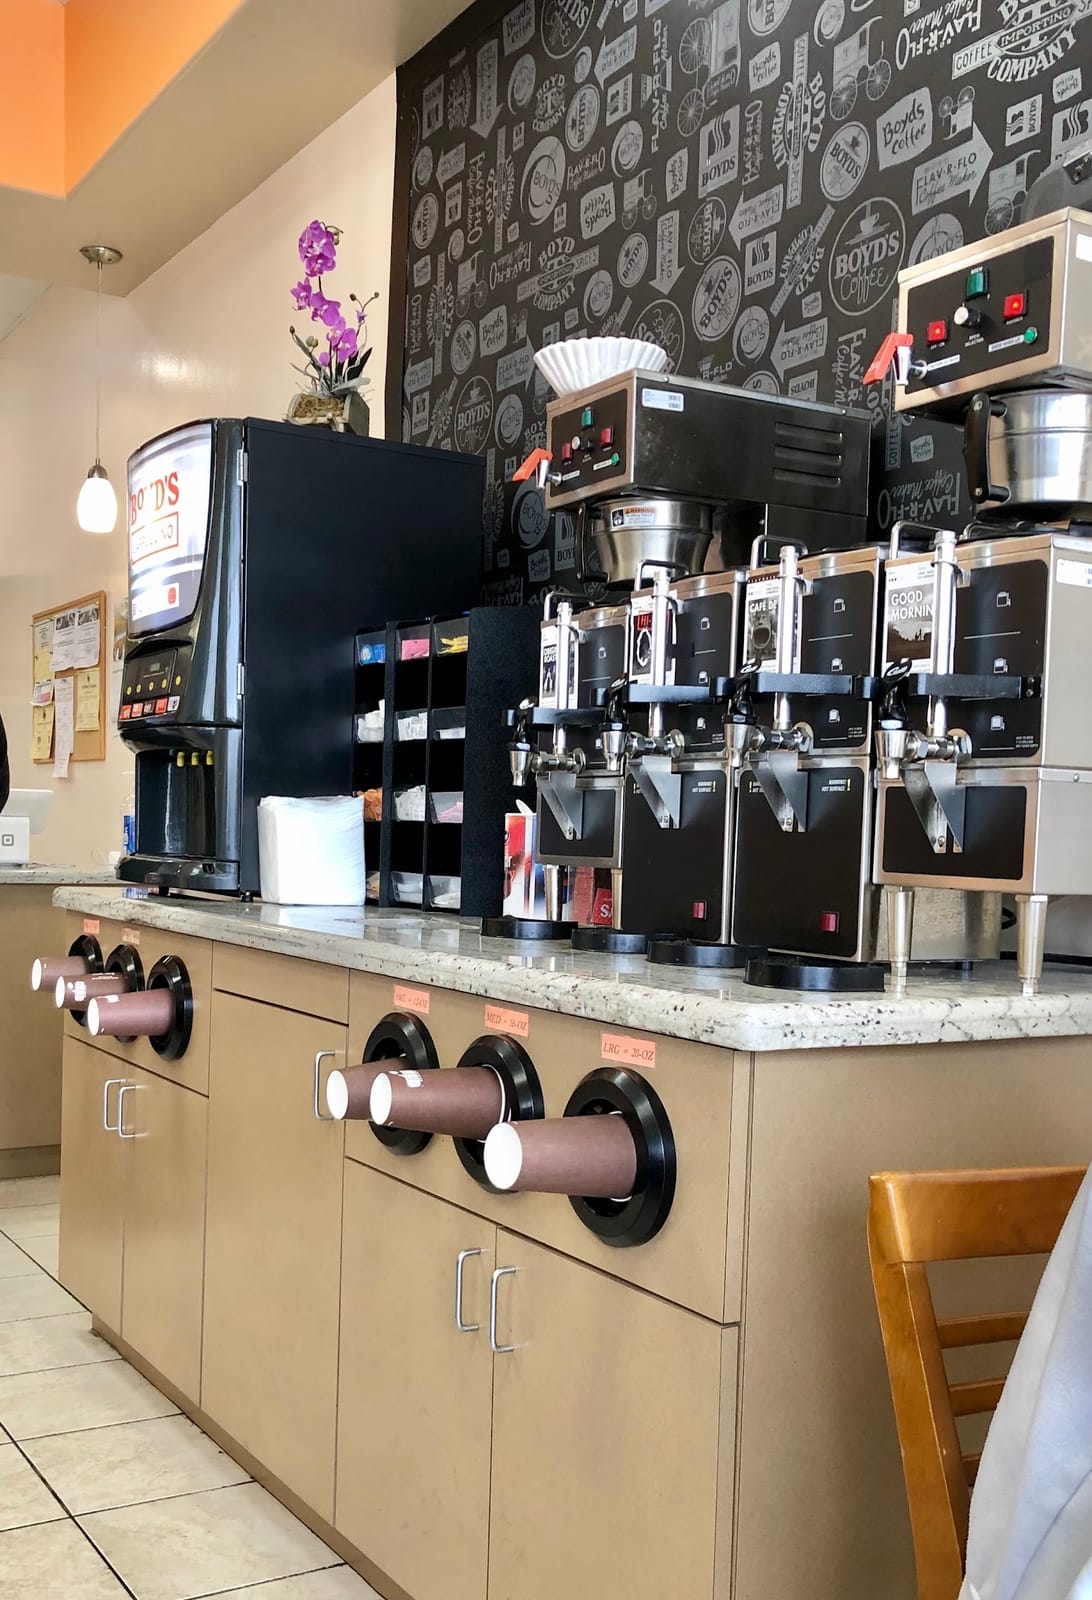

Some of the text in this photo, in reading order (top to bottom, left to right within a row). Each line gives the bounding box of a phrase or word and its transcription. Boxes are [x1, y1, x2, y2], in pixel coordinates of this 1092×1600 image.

[1000, 7, 1072, 47] IMPORTING
[955, 40, 993, 71] COFFEE
[986, 21, 1077, 83] COMPANY
[882, 97, 926, 148] Boyds
[891, 122, 927, 155] coffee
[701, 155, 737, 188] BOYDS
[834, 230, 901, 280] BOYD'S
[746, 268, 774, 288] BOYDS
[840, 266, 890, 306] Coffee
[456, 400, 492, 431] BOYD'S
[130, 471, 180, 527] BOD'S
[749, 599, 767, 614] CAFÉ
[890, 603, 934, 621] MORNIN
[891, 590, 924, 606] GOOD
[602, 1042, 621, 1055] LRG
[631, 1047, 655, 1062] 20-OZ
